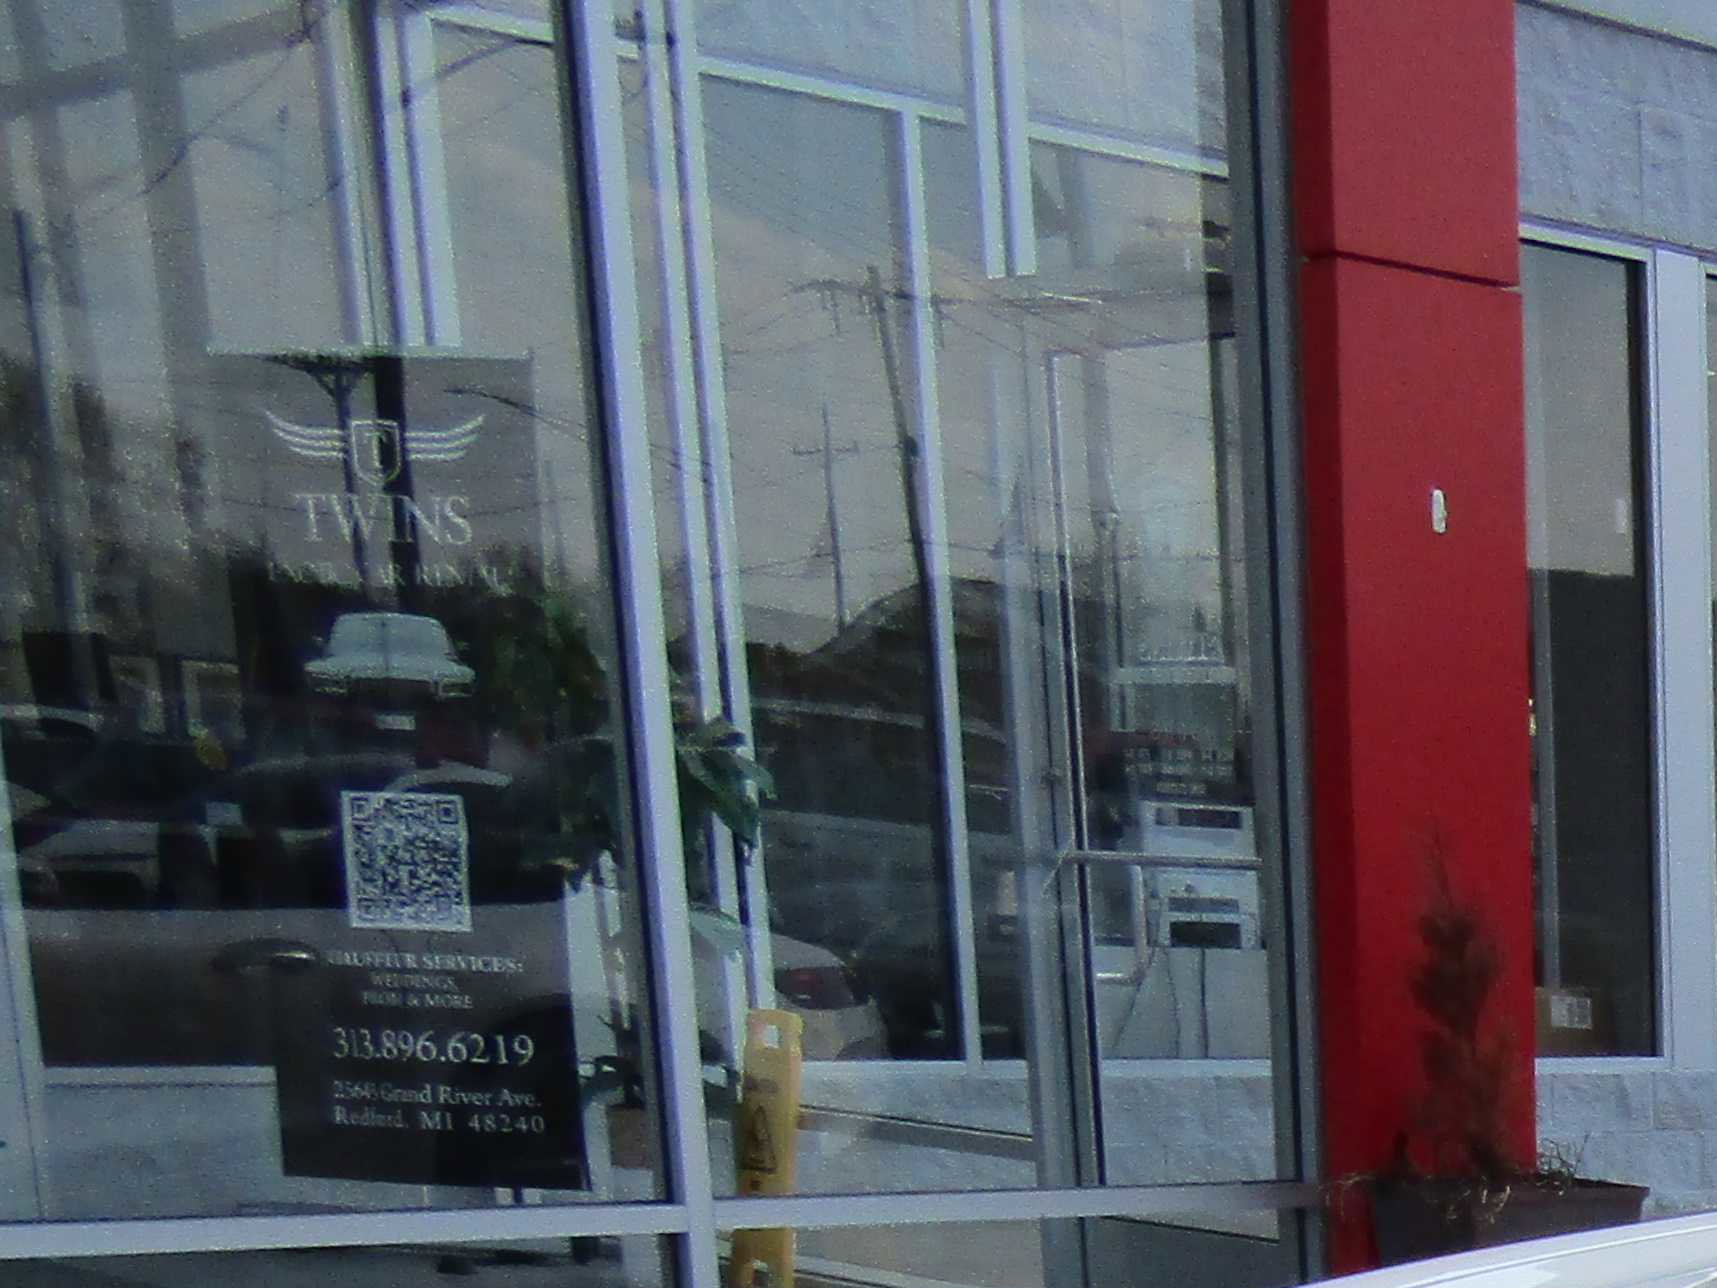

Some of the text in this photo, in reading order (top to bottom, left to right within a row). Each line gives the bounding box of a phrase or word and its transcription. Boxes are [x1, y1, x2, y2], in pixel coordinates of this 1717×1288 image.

[294, 493, 473, 545] TWINS
[333, 1026, 535, 1066] 313.896.6219
[438, 1085, 492, 1106] River
[499, 1088, 542, 1108] Ave.
[420, 1111, 453, 1131] MI
[467, 1114, 545, 1134] 48240
